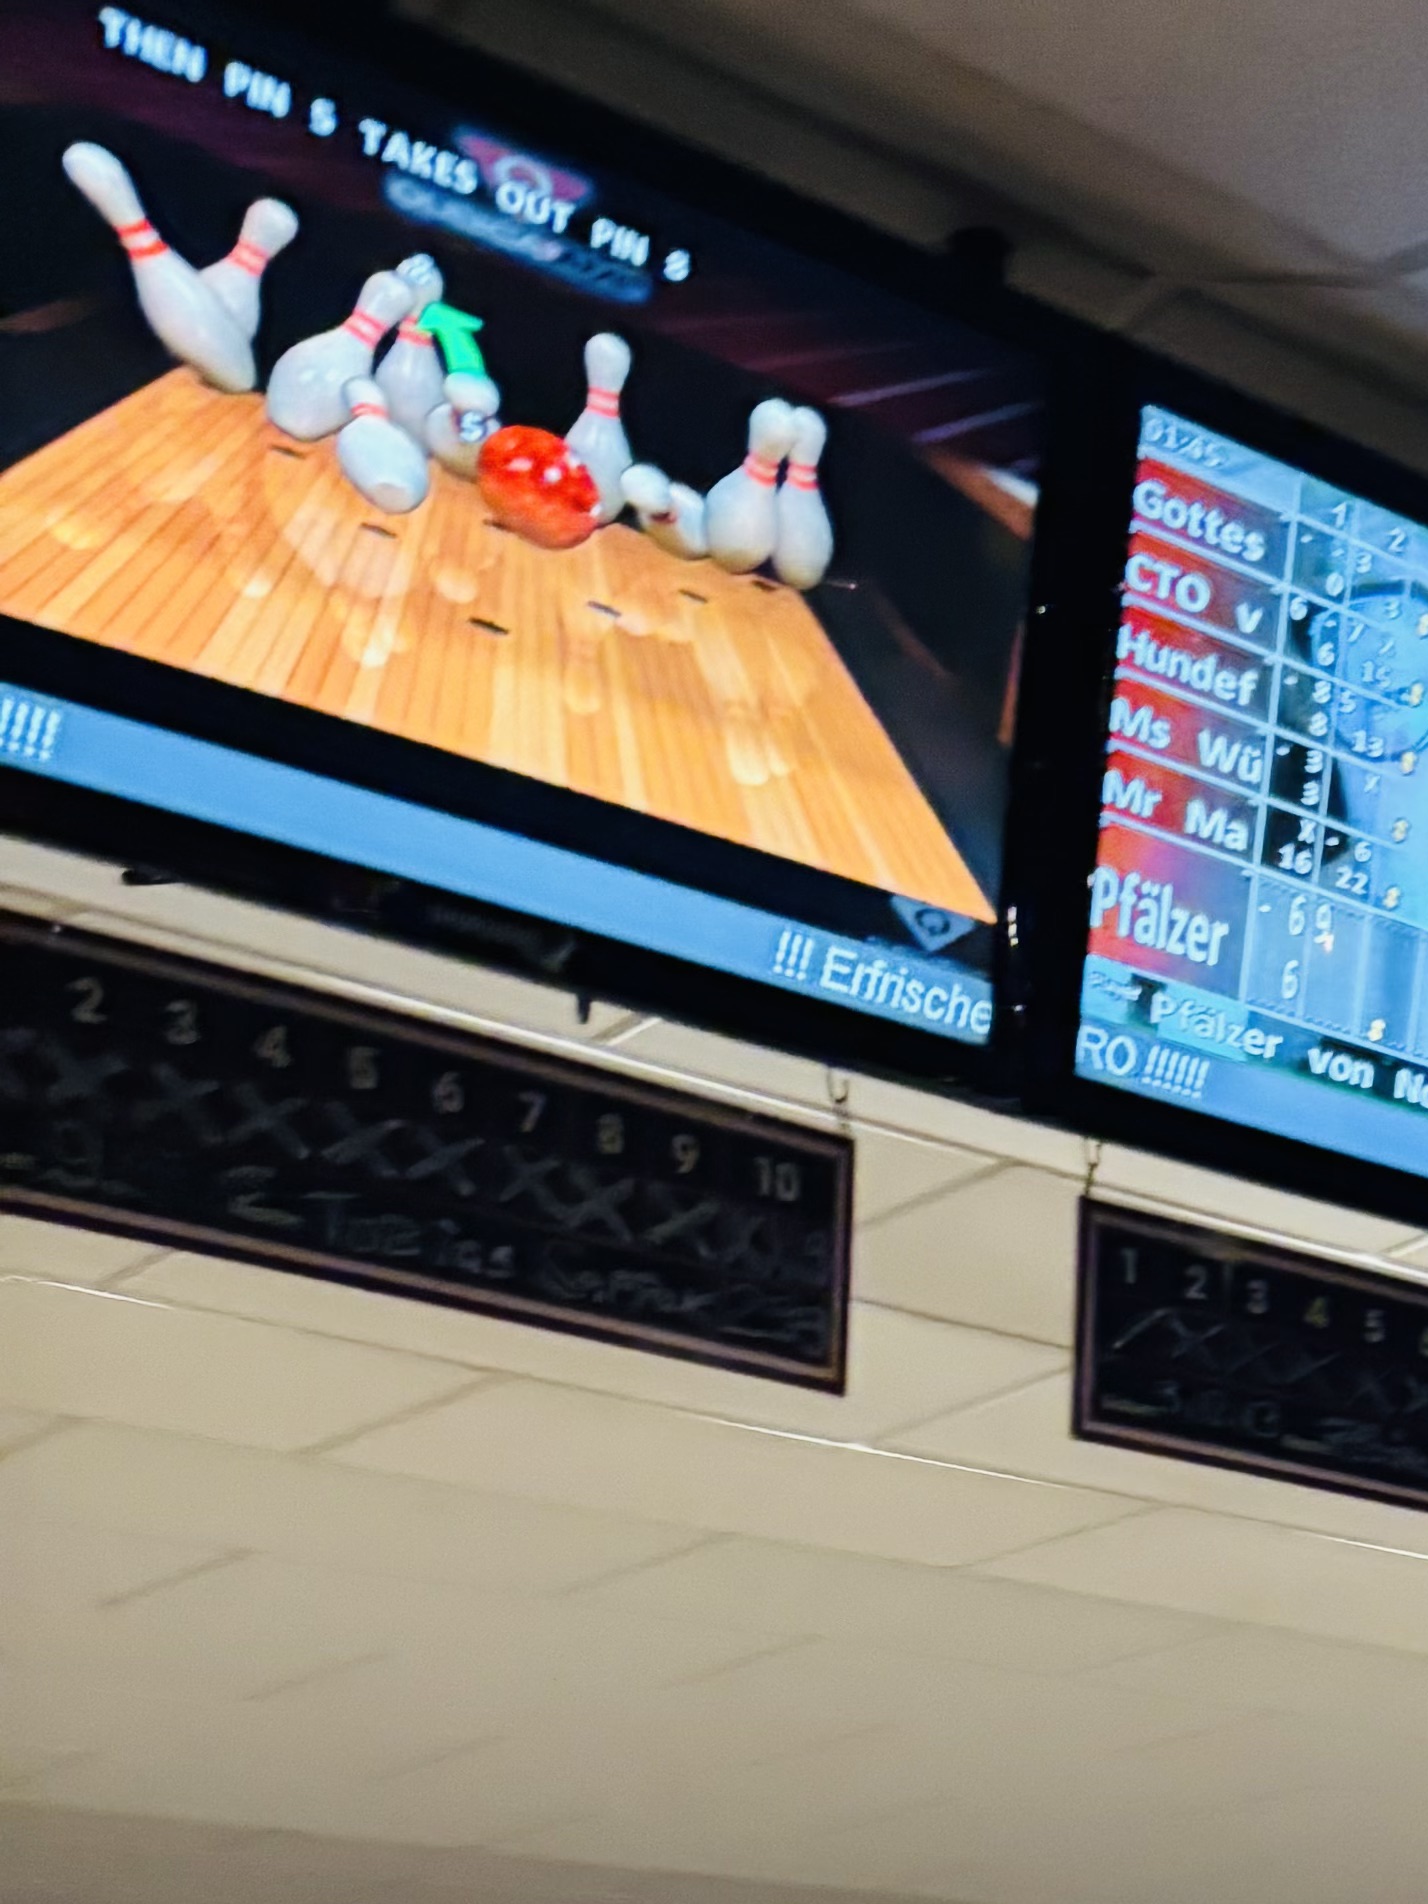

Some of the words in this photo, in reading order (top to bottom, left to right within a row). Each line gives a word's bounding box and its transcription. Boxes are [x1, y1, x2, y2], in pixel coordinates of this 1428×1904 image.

[99, 6, 208, 83] THEN
[223, 60, 292, 119] PIN
[358, 117, 479, 195] TAKES
[495, 180, 577, 234] OUT
[590, 218, 650, 267] PIN
[1131, 478, 1267, 562] Gottes
[1325, 572, 1345, 597] 0
[1332, 501, 1347, 527] 1
[1388, 526, 1407, 552] 2
[1125, 551, 1212, 613] CTO
[1235, 601, 1264, 633] v
[1316, 642, 1336, 667] 6
[1289, 597, 1308, 622] 6
[1115, 623, 1260, 706] Hundef
[1352, 730, 1384, 758] 13
[1108, 697, 1172, 750] Ms
[1197, 728, 1263, 784] Wü
[1300, 780, 1321, 806] 3
[1304, 749, 1324, 774] 3
[1101, 768, 1163, 819] Mr
[1183, 797, 1250, 851] Ma
[1278, 842, 1313, 875] 16
[1336, 866, 1368, 895] 22
[1353, 841, 1372, 863] 6
[1089, 865, 1230, 967] Pfälzer
[1281, 959, 1300, 999] 6
[1288, 895, 1306, 936] 6
[819, 946, 993, 1035] Erfrische
[1076, 1025, 1137, 1076] RO
[1151, 991, 1283, 1058] Pfälzer
[1307, 1047, 1376, 1089] von
[70, 976, 109, 1024] 2
[163, 998, 200, 1045] 3
[251, 1025, 294, 1068] 4
[346, 1046, 383, 1089] 5
[431, 1071, 466, 1116] 6
[517, 1090, 548, 1134] 7
[595, 1112, 626, 1155] 8
[671, 1134, 701, 1175] 9
[752, 1155, 801, 1203] 10
[1121, 1248, 1139, 1285] 1
[1184, 1264, 1208, 1300] 2
[1246, 1279, 1269, 1315] 3
[1304, 1296, 1331, 1329] 4
[1363, 1309, 1386, 1343] 5
